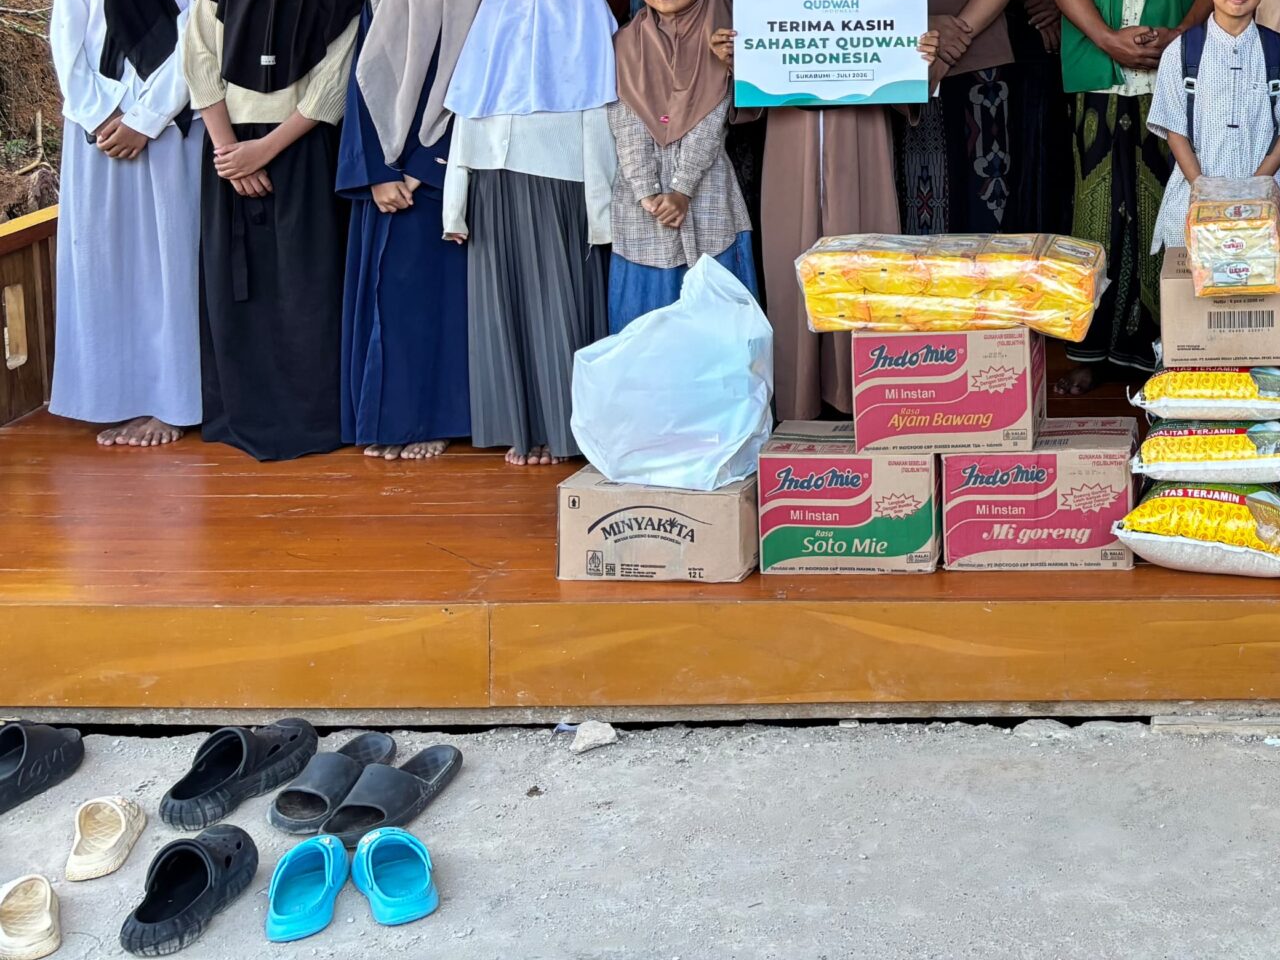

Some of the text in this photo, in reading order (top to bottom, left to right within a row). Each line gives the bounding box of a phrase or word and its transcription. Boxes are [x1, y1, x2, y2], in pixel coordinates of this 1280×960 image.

[803, 0, 859, 10] QUDWAH
[767, 19, 895, 32] TERIMA KASIH
[744, 36, 918, 51] SAHABAT QUDWAH
[782, 52, 881, 65] INDONESIA
[885, 388, 936, 399] Mi Instan
[899, 407, 920, 415] Rasa
[887, 412, 993, 431] Ayam Bawang
[1187, 489, 1240, 503] TERJAMIN
[790, 510, 840, 521] Mi Instan
[976, 504, 1026, 515] Mi Instan
[982, 523, 1091, 544] Mi goreng
[802, 537, 888, 554] Soto Mie
[605, 564, 616, 573] SNI
